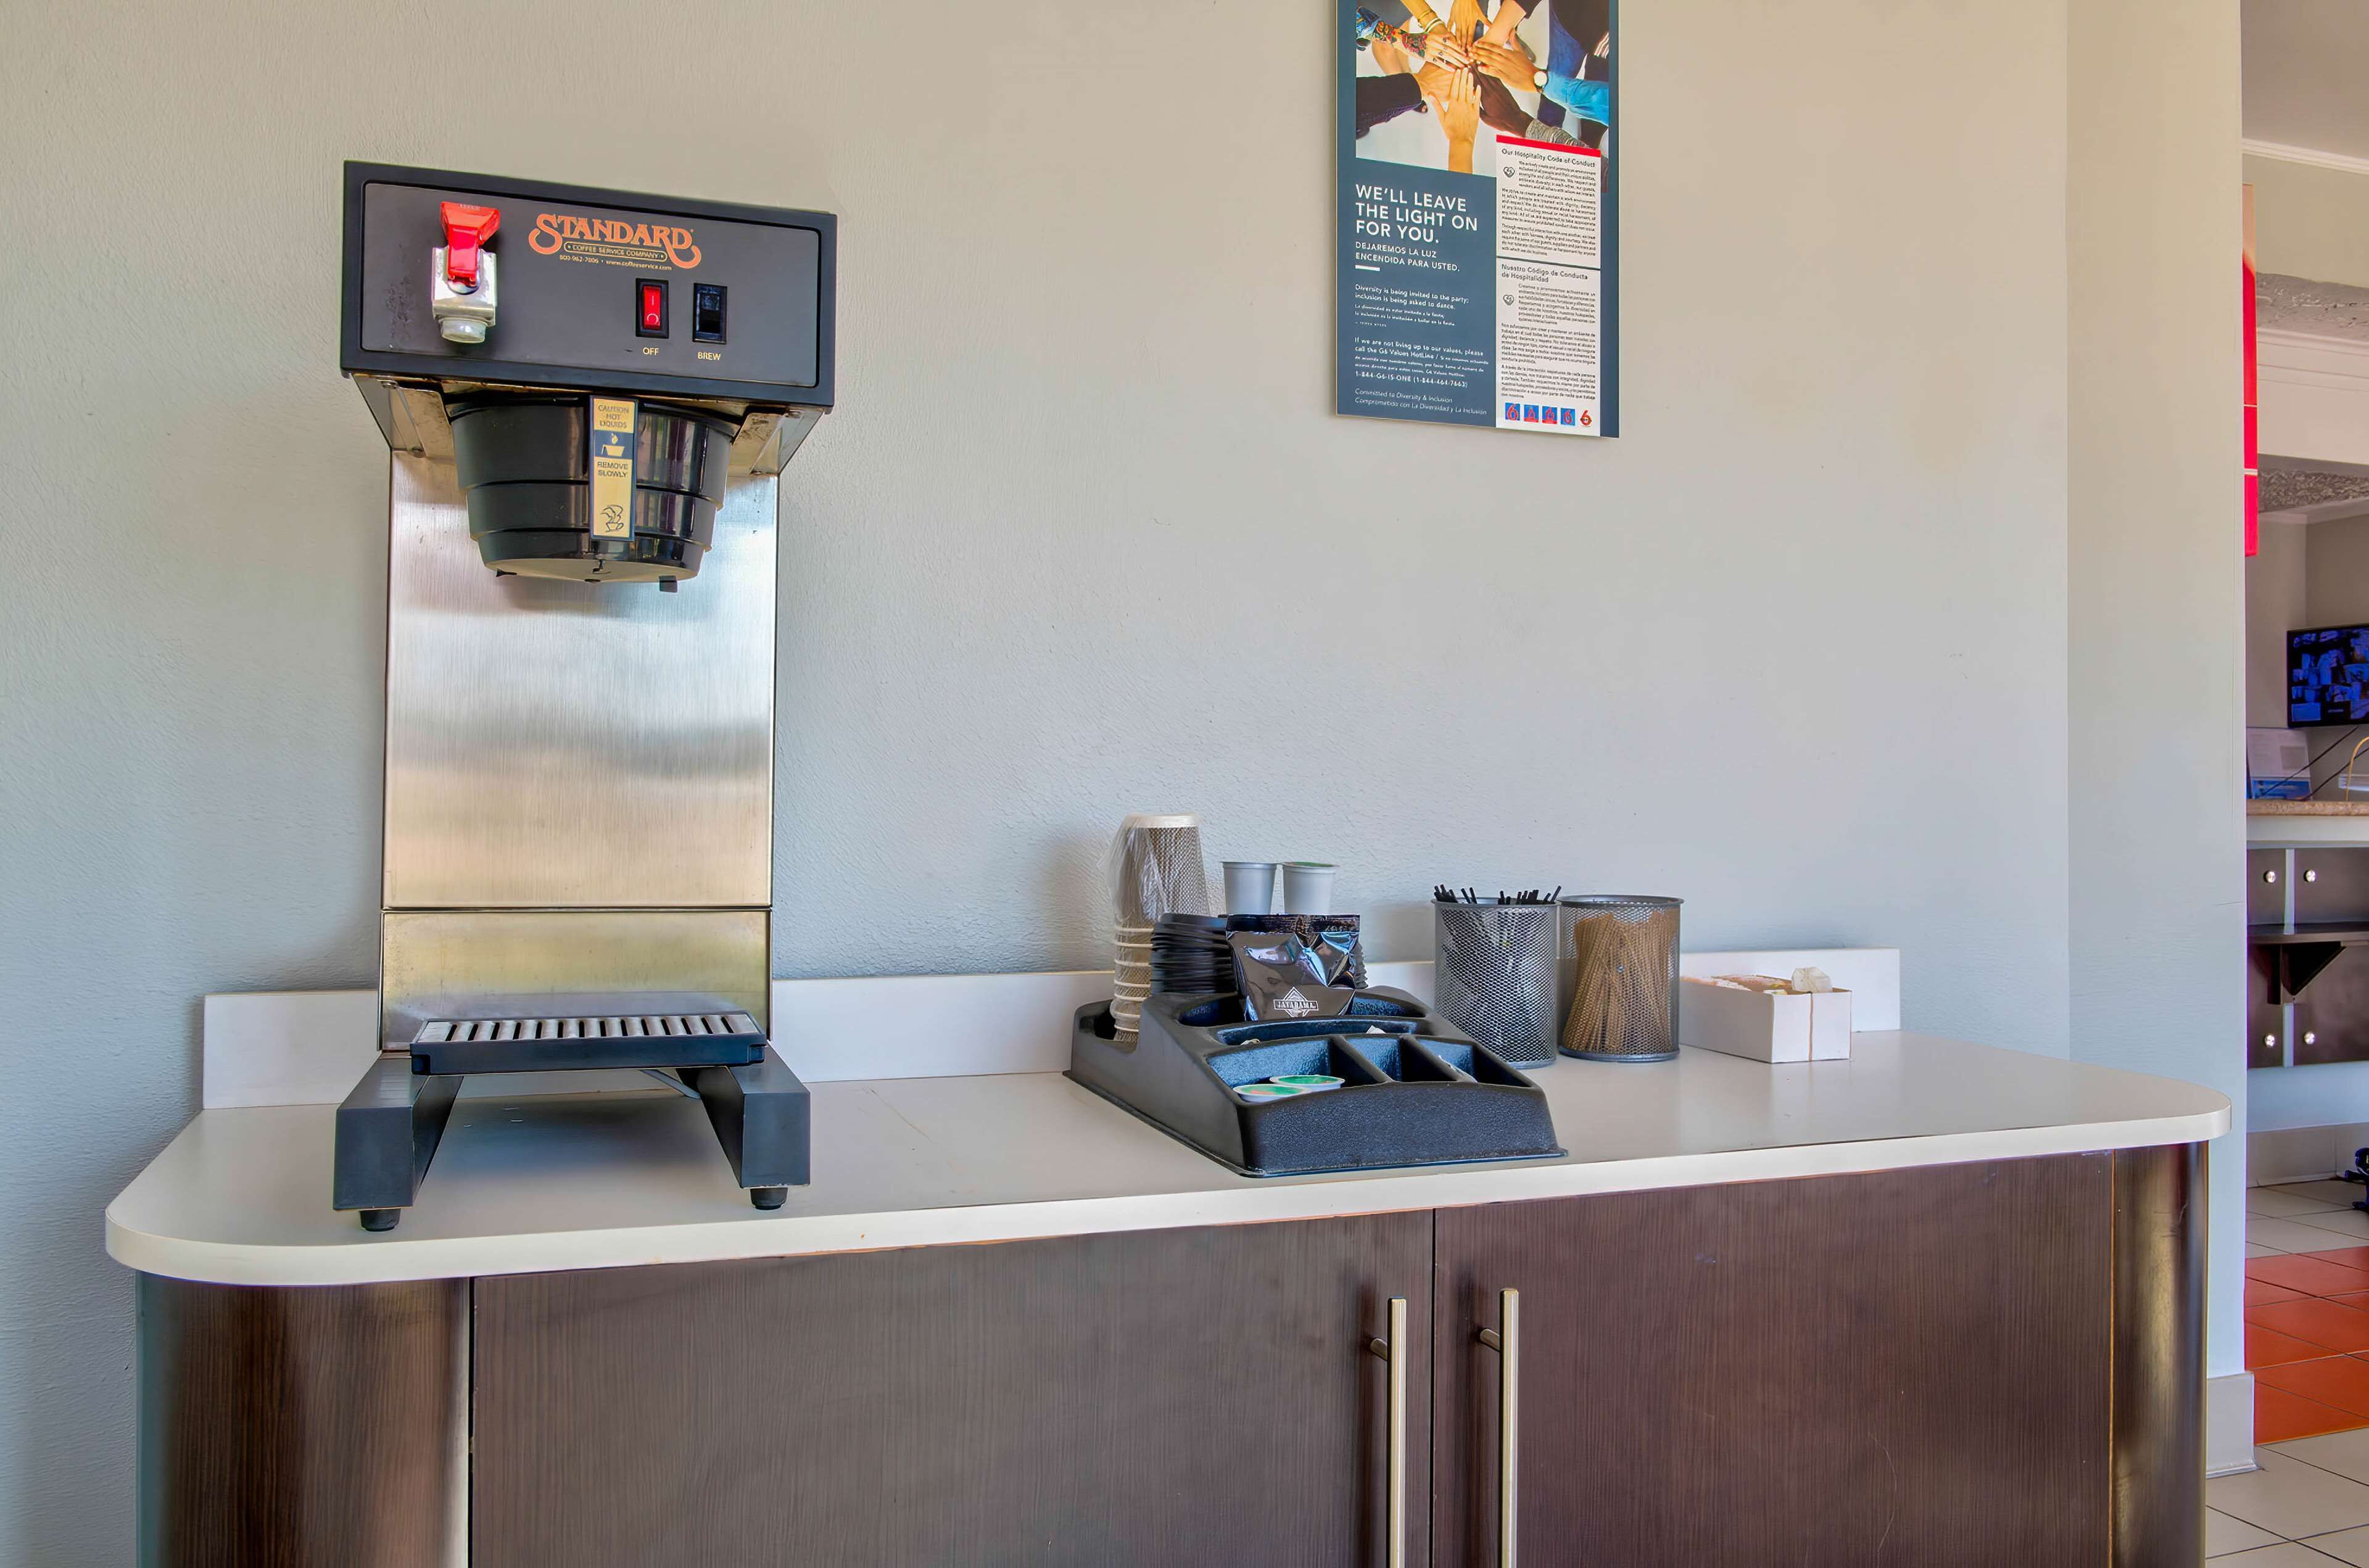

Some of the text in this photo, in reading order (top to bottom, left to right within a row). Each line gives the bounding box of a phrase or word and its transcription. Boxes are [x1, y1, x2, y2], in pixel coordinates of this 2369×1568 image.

[1515, 150, 1546, 162] Hospitality
[1547, 154, 1563, 163] Code
[1571, 158, 1595, 168] Conduct
[1414, 192, 1466, 212] LEAVE
[1355, 202, 1478, 231] THE LIGHT ON
[1356, 220, 1439, 244] FOR YOU.
[529, 213, 701, 269] STANDARD
[573, 244, 660, 259] COFFEE SERVICE COMPANY
[1355, 241, 1437, 258] DEJAREMOS LA LUZ
[1355, 252, 1460, 272] ENCENDIDA PARA USTED.
[1502, 263, 1526, 273] Nuestro
[1560, 271, 1589, 280] Conducta
[1355, 284, 1383, 294] Diversity
[1390, 288, 1408, 297] being
[1409, 290, 1430, 299] invited
[1390, 296, 1407, 306] being
[642, 347, 659, 356] OFF
[697, 351, 721, 361] BREW
[598, 404, 629, 414] CAUTION
[600, 420, 627, 429] LIQUIDS
[1580, 409, 1592, 426] 6
[597, 461, 628, 470] REMOVE
[598, 469, 628, 479] SLOWLY
